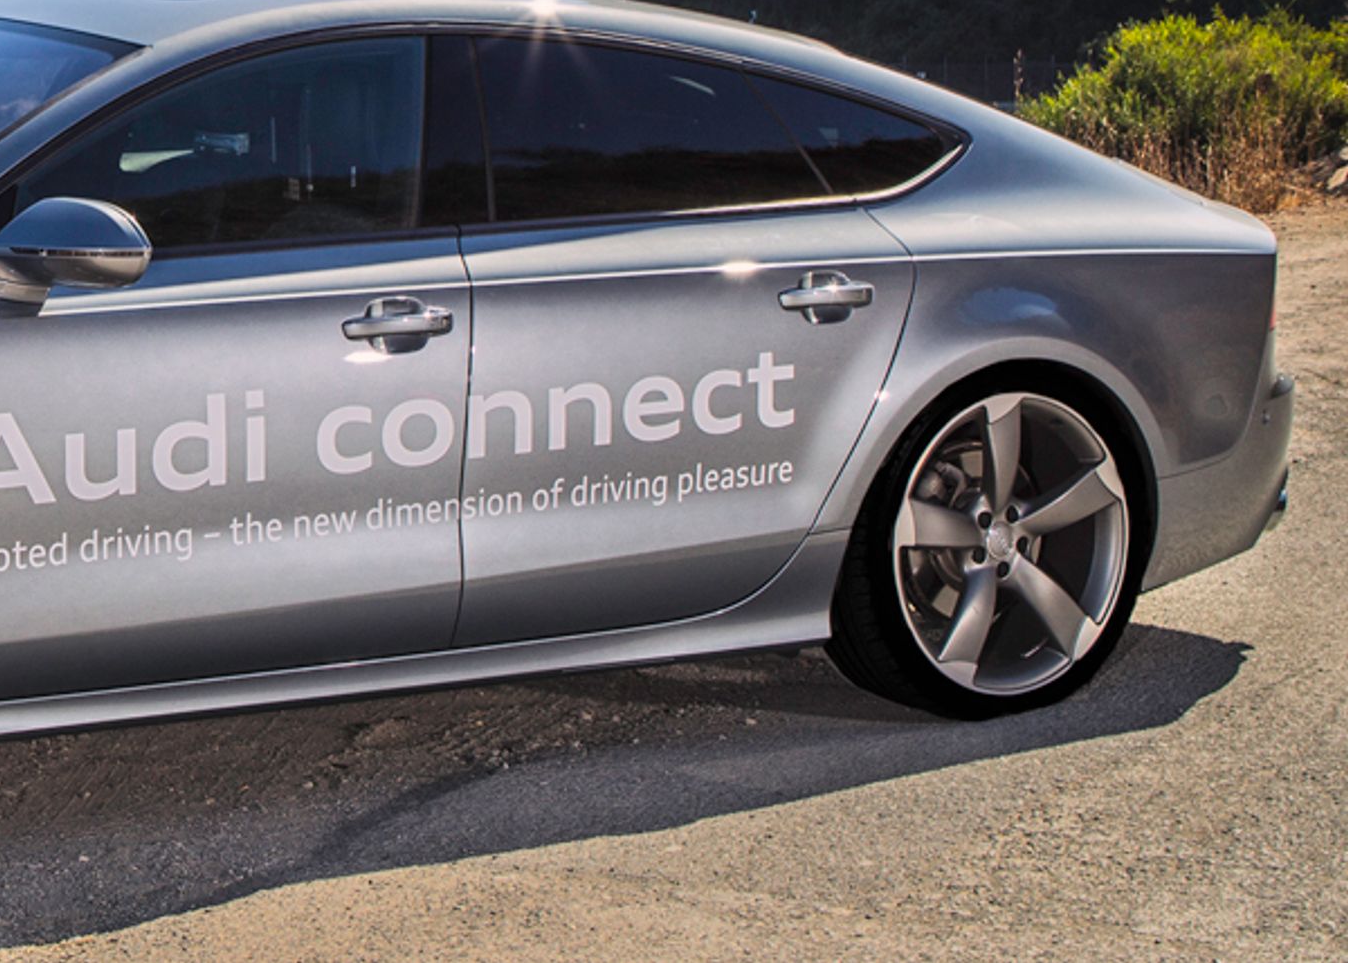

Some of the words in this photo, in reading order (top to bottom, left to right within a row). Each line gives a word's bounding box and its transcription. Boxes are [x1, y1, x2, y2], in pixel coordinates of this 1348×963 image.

[316, 352, 795, 474] connect
[80, 525, 193, 560] driving
[229, 512, 283, 545] the
[293, 509, 358, 538] new
[366, 488, 523, 530] dimension
[532, 477, 566, 511] of
[571, 471, 668, 506] driving
[677, 459, 794, 502] pleasure
